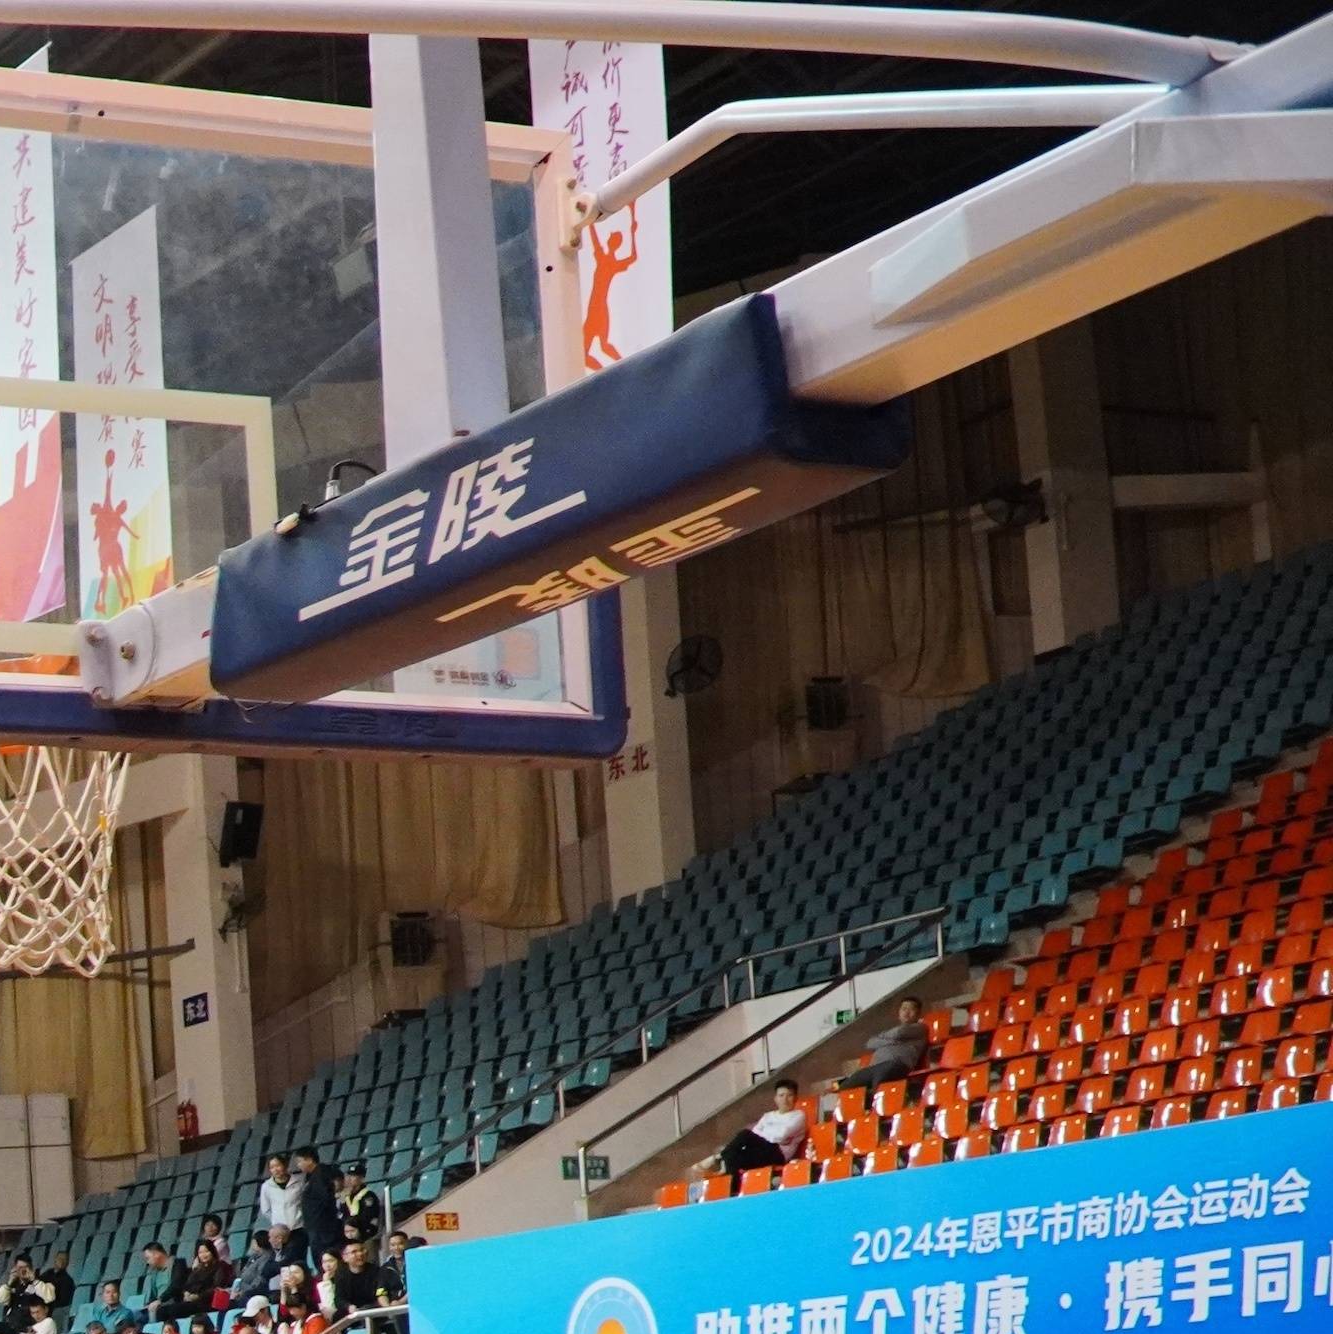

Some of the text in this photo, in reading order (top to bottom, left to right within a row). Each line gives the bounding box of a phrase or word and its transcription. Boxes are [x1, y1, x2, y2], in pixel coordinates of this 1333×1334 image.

[299, 438, 587, 622] 金陵
[608, 744, 651, 781] 东北
[850, 1166, 1311, 1267] 2024年恩平市商协会运动会
